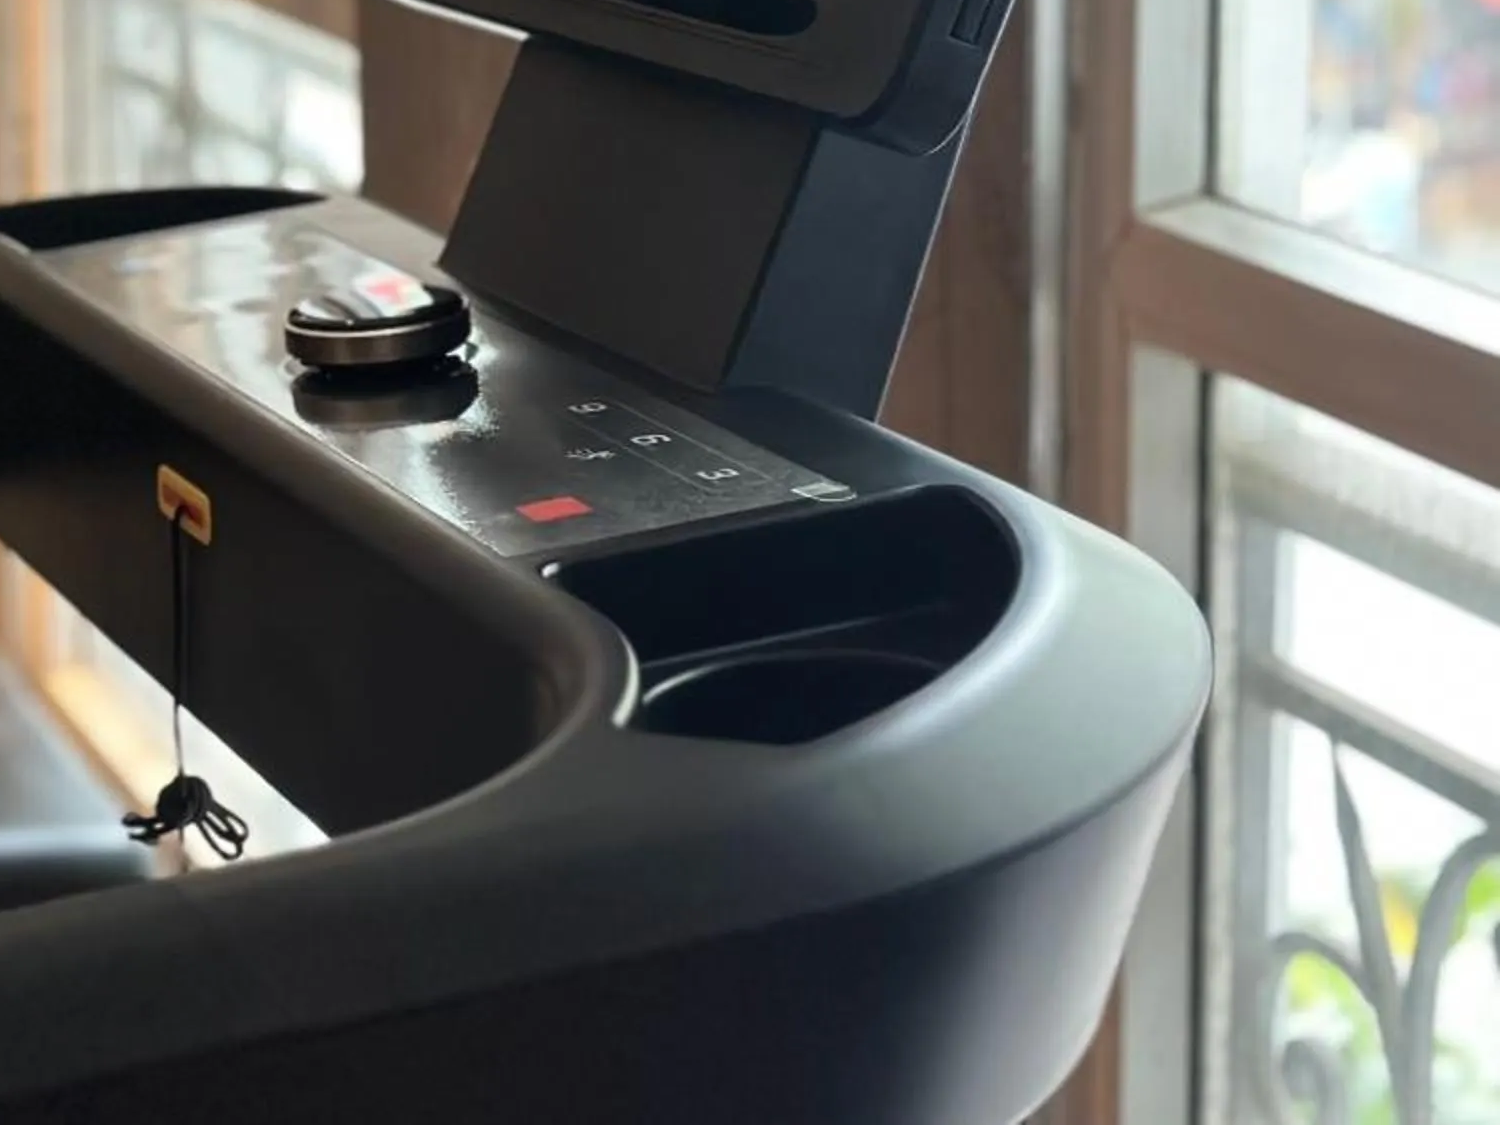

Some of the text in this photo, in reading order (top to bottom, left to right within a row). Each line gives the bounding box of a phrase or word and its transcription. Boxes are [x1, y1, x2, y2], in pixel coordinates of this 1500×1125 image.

[567, 400, 741, 481] 9 6 3
